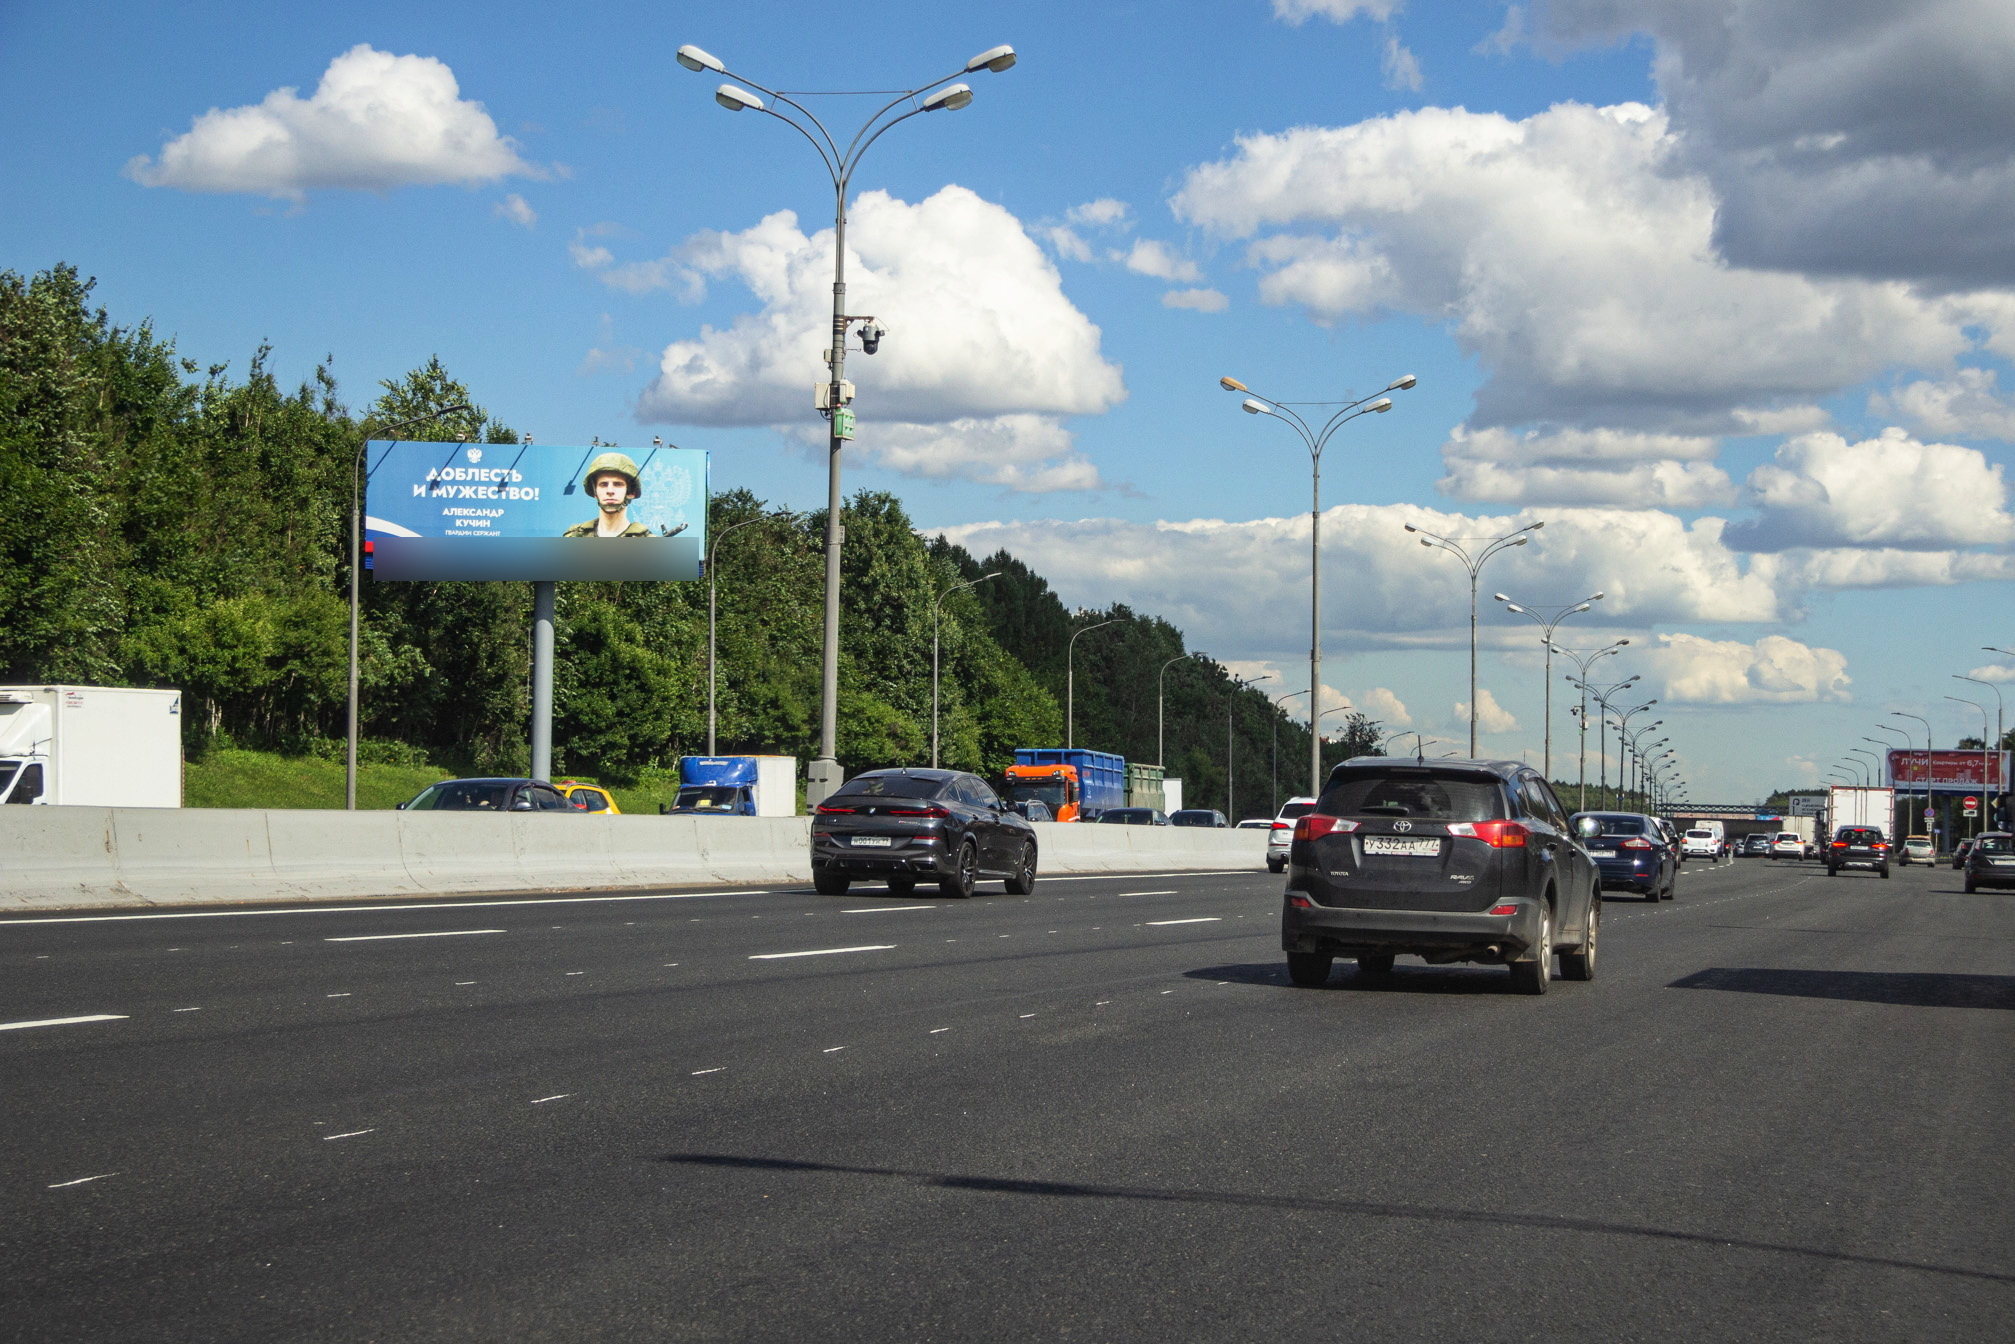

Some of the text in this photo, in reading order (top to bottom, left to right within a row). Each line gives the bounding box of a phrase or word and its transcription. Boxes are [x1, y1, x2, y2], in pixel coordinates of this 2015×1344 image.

[426, 467, 523, 483] ДОБЛЕСТЬ
[413, 484, 540, 501] И МУЖЕСТВО!
[442, 508, 505, 518] АЛЕКСАНДР
[455, 519, 491, 528] КУЧИН
